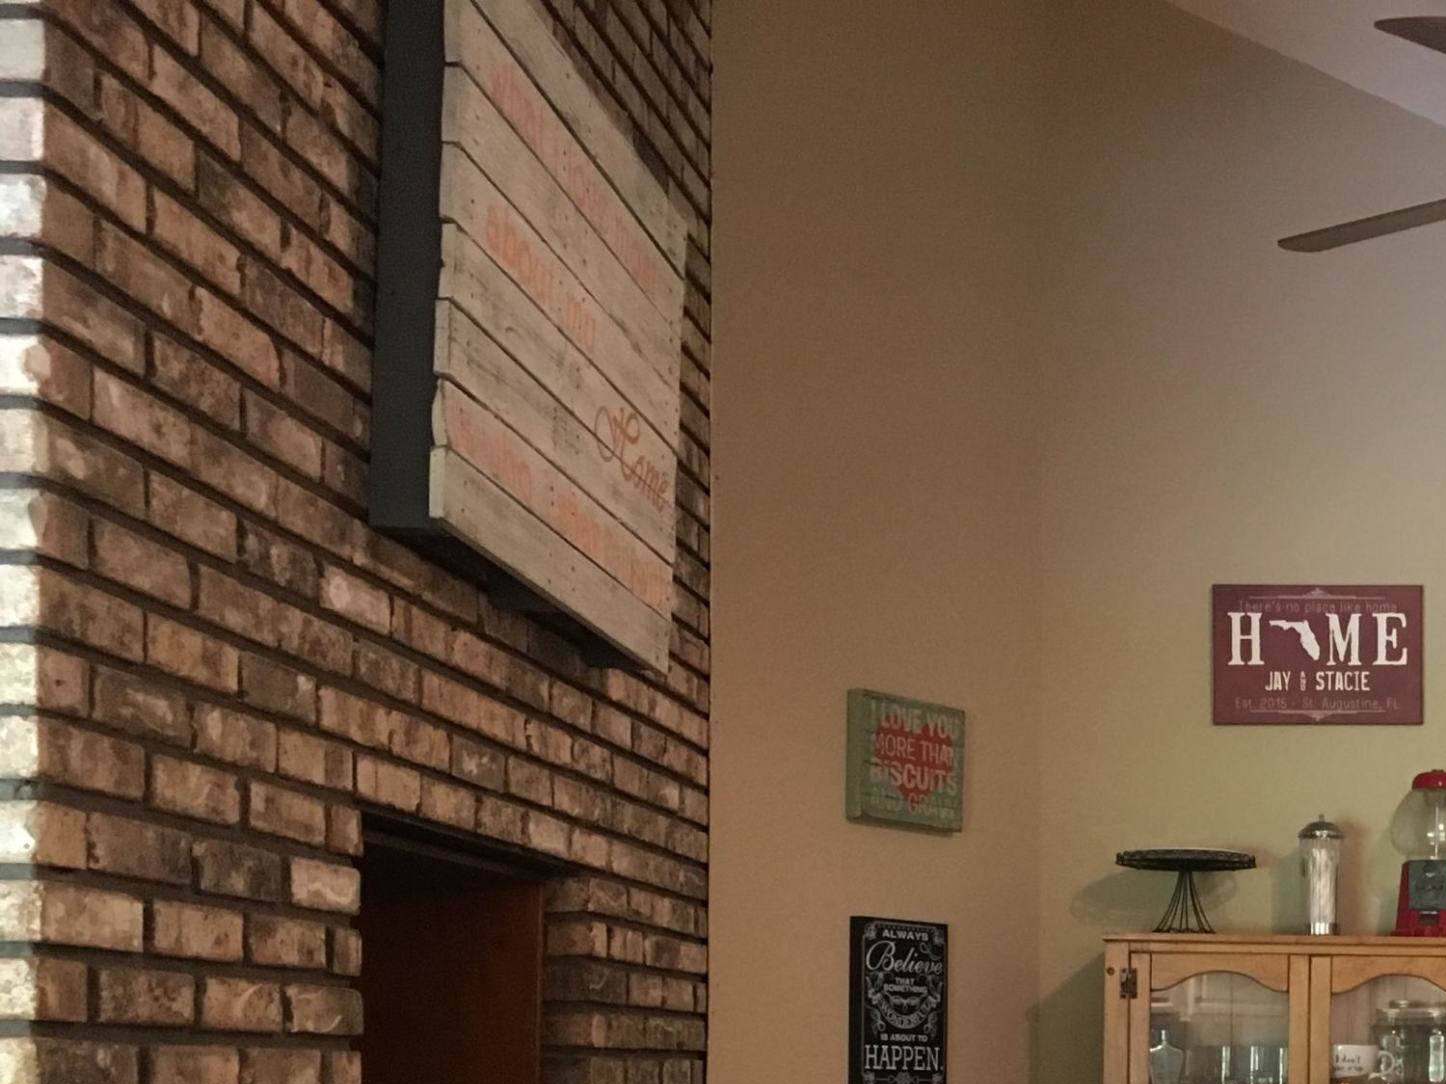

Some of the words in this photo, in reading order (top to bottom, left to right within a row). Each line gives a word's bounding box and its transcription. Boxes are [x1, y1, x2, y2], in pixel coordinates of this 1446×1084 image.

[595, 405, 669, 513] Home
[1285, 602, 1298, 613] no
[1304, 600, 1336, 614] place
[1340, 600, 1361, 613] like
[1265, 671, 1291, 691] JAY
[1315, 671, 1371, 691] STACIE
[880, 701, 922, 735] LOVE
[926, 710, 960, 739] YOU
[870, 733, 916, 760] MORE
[870, 757, 958, 796] BISCUITS
[882, 929, 929, 941] ALWAYS
[865, 940, 943, 974] Believe
[895, 977, 915, 986] THAT
